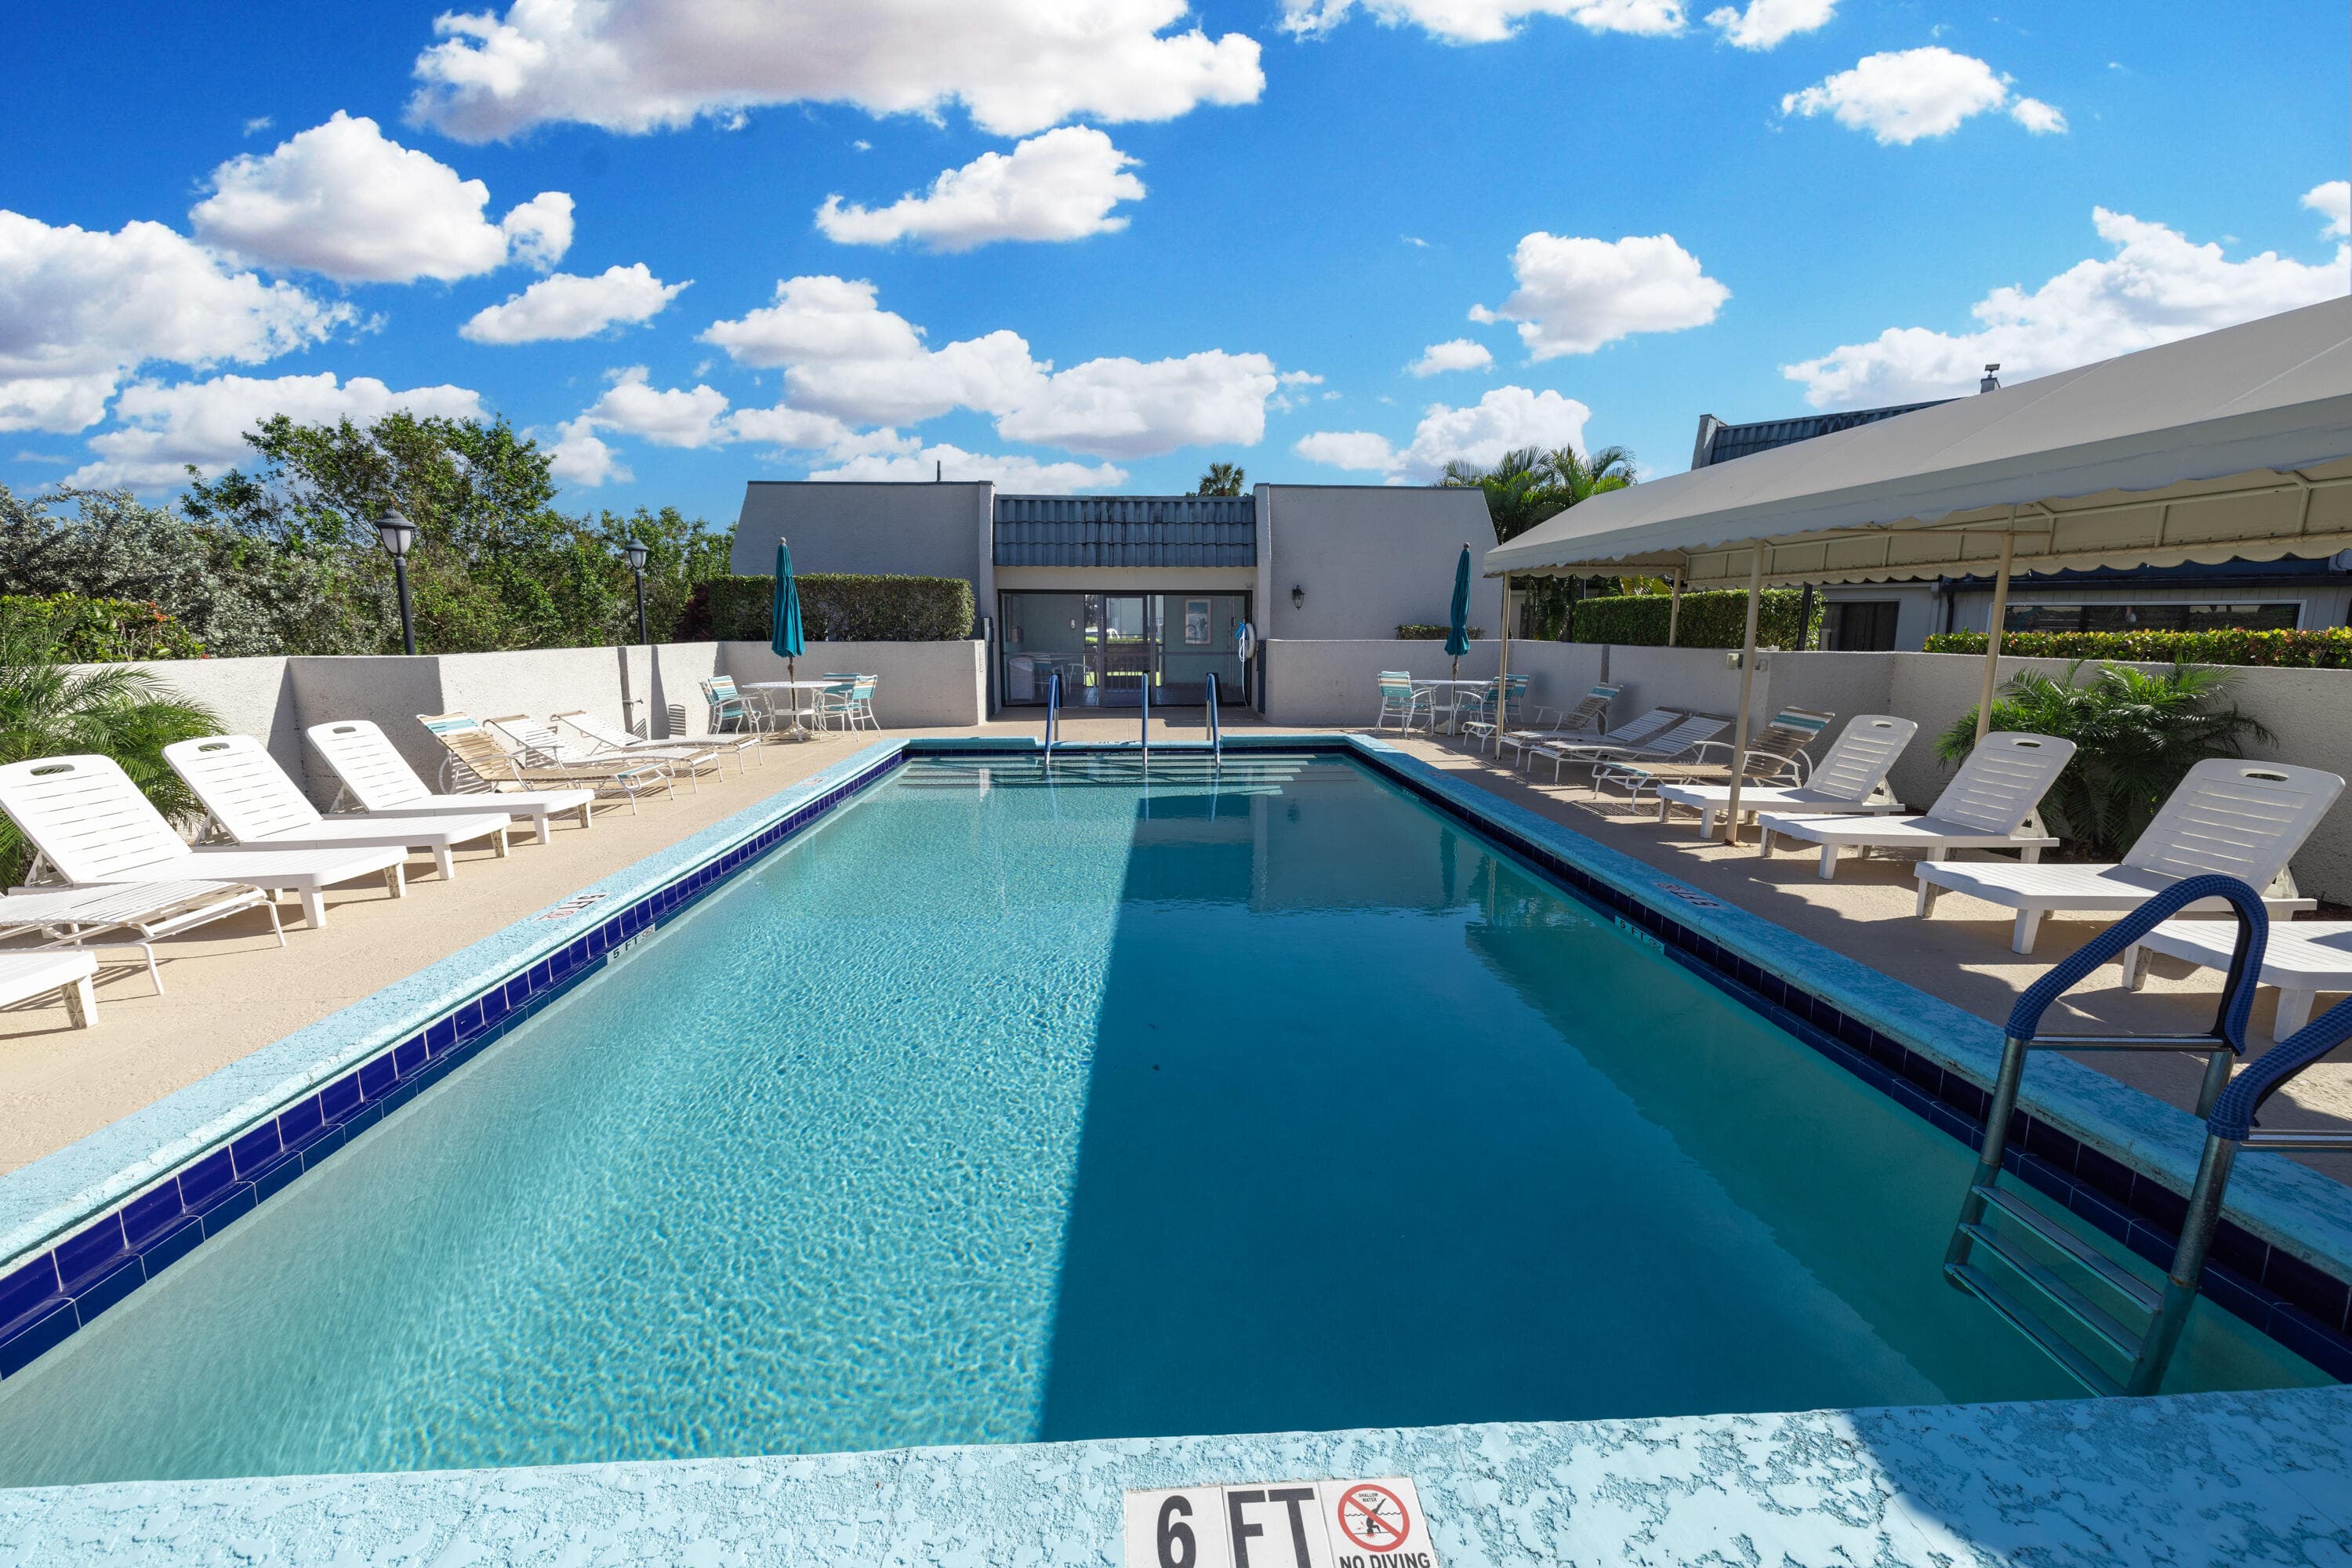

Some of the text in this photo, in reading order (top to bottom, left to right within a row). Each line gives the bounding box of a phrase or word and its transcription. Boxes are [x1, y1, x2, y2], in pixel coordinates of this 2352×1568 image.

[1619, 920, 1646, 941] 5 FT
[613, 934, 640, 959] 5 FT
[1156, 1487, 1316, 1568] 6 FT
[1339, 1552, 1431, 1568] NO DIVING
